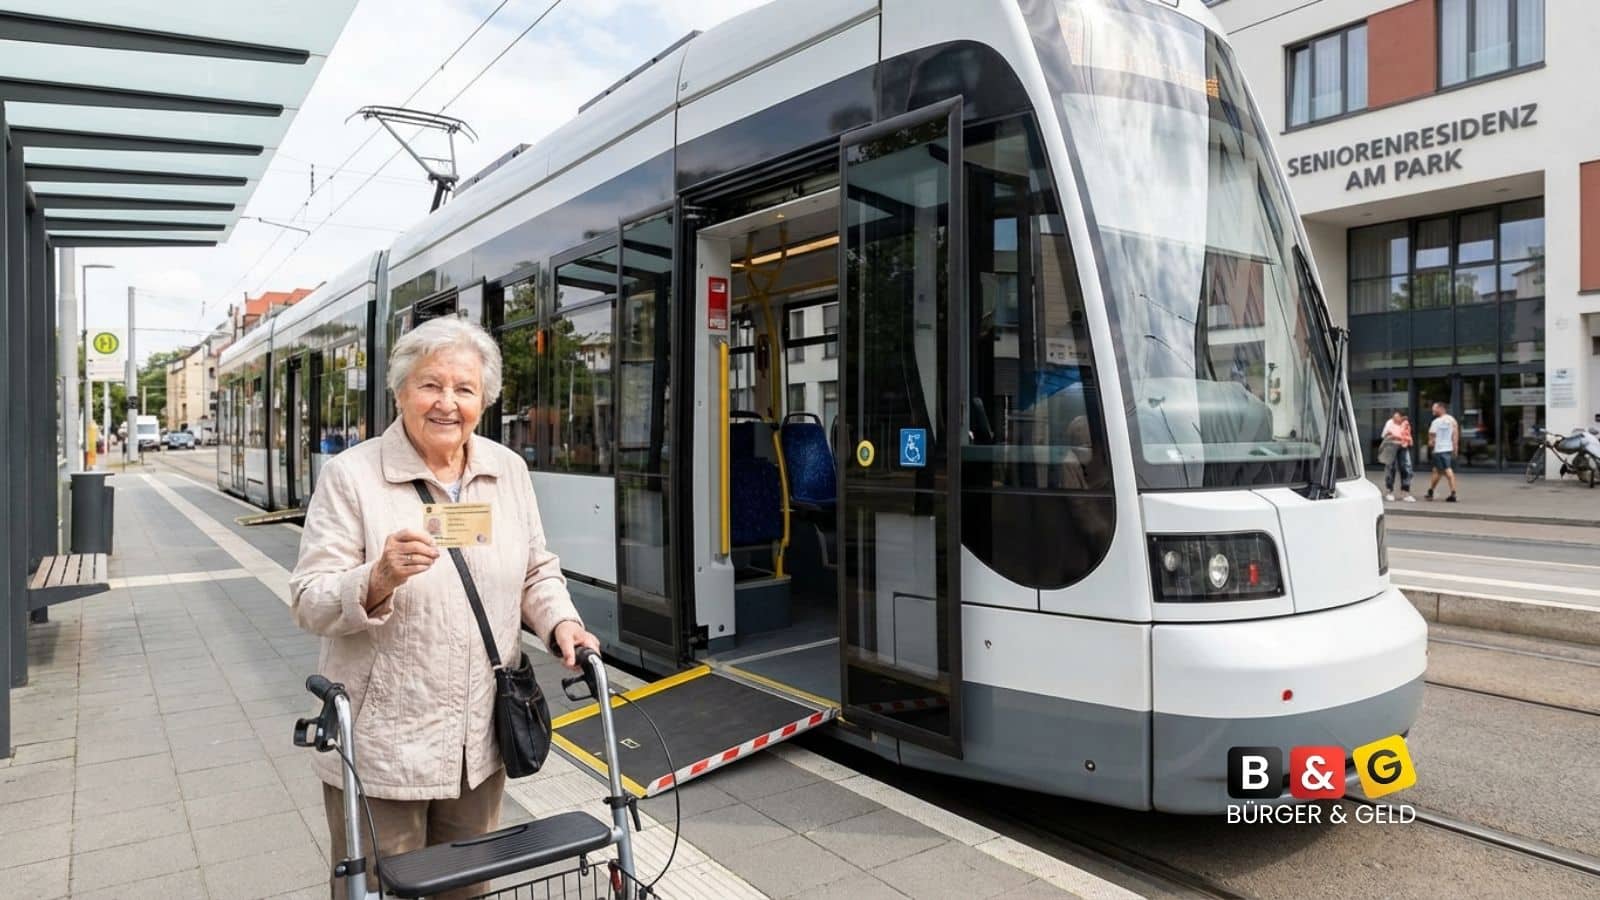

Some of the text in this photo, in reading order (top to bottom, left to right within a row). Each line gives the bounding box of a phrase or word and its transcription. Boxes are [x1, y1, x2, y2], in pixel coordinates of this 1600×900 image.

[1287, 103, 1538, 178] SENIORENRESIDENZ
[1345, 149, 1463, 192] AM PARK
